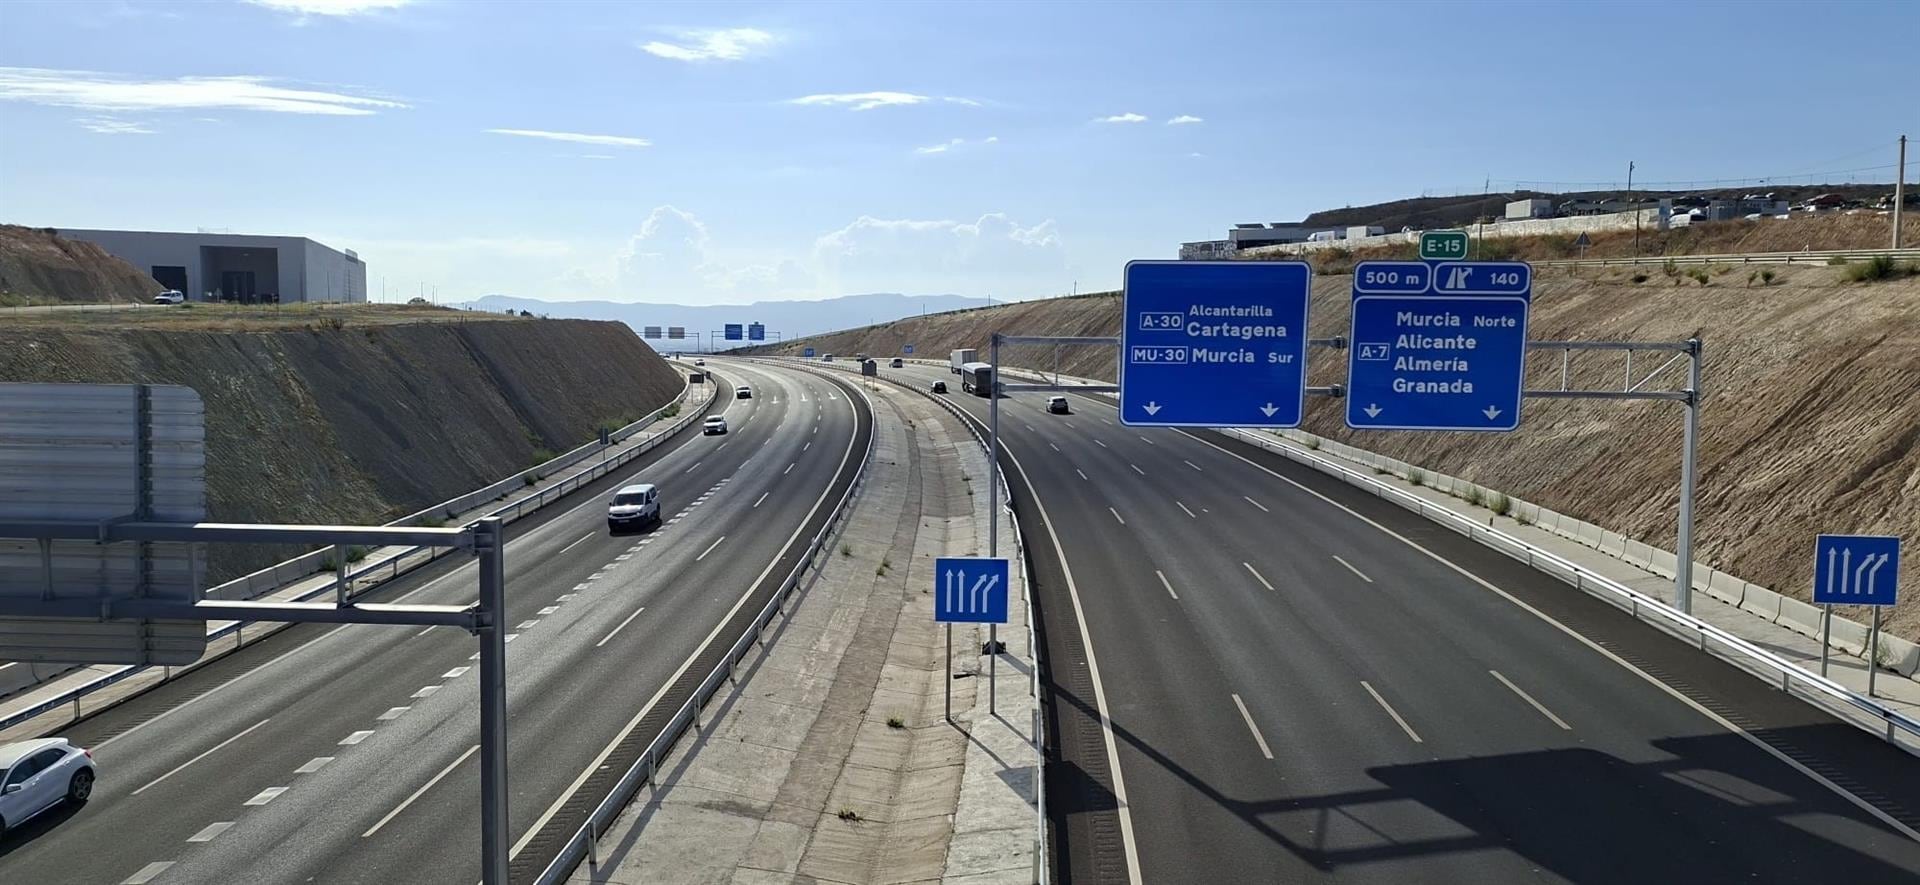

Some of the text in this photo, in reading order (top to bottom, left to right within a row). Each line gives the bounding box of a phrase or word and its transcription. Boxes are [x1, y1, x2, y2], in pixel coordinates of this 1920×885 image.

[1427, 240, 1460, 252] E-15
[1365, 272, 1420, 285] 500 m
[1490, 273, 1519, 285] 140
[1189, 305, 1273, 317] Alcantarilla
[1143, 316, 1181, 327] A-30
[1396, 312, 1516, 327] Murcia Norte
[1187, 322, 1287, 340] Cartagena
[1395, 334, 1477, 349] Alicante
[1134, 348, 1294, 364] MU-30 Murcia Sur
[1360, 346, 1387, 358] A-7
[1394, 356, 1468, 372] Almería
[1392, 378, 1473, 393] Granada
